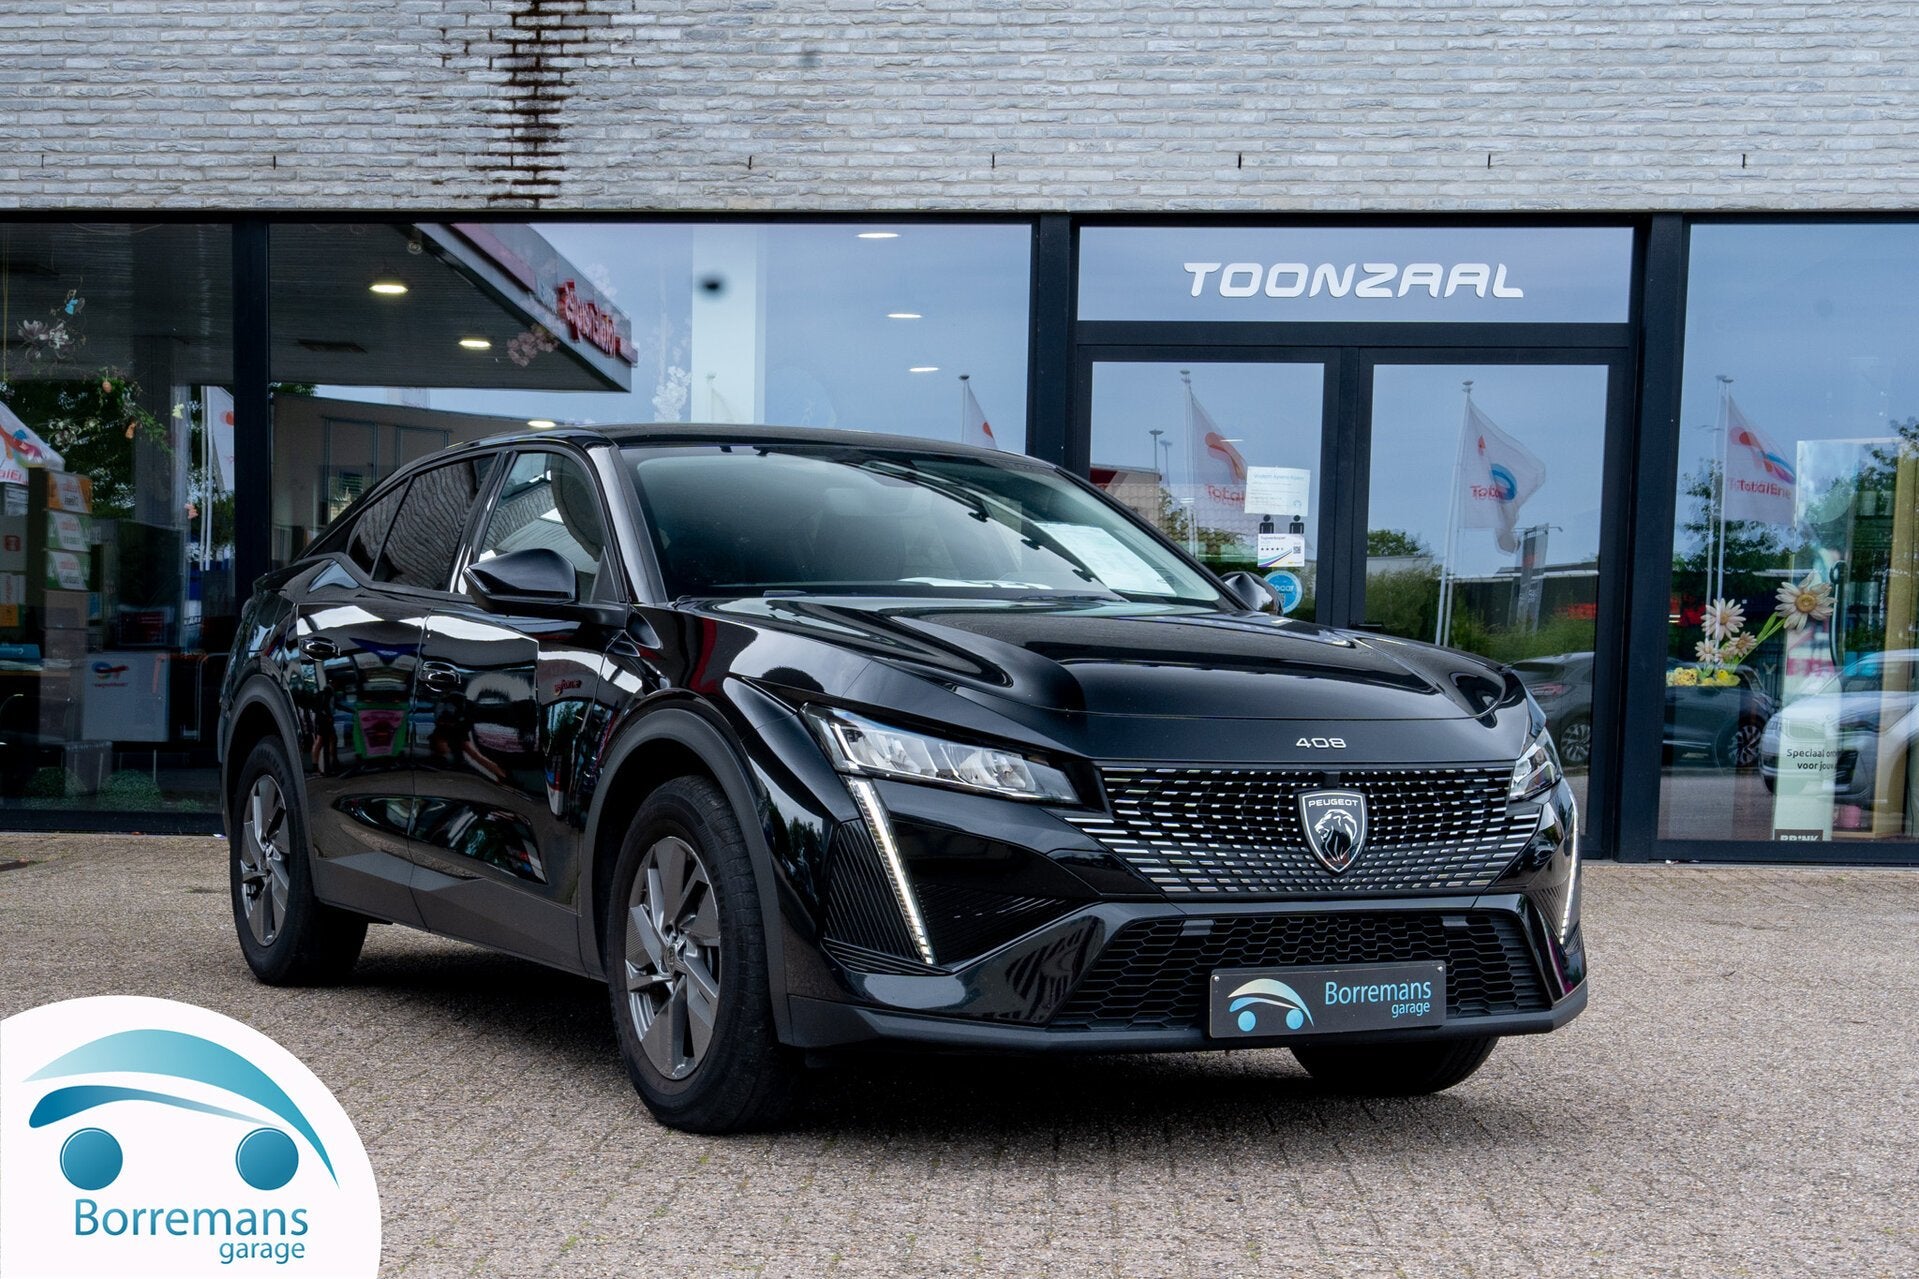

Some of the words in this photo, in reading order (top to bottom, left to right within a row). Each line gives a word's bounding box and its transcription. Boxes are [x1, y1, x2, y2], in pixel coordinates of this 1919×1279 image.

[1183, 262, 1524, 298] TOONZAAL
[1295, 737, 1348, 748] 408
[1786, 748, 1825, 759] Speciaal
[1797, 761, 1818, 770] voor
[1308, 798, 1358, 808] PEUGEOT
[1325, 981, 1432, 1006] Borremans
[1391, 1002, 1431, 1018] garage
